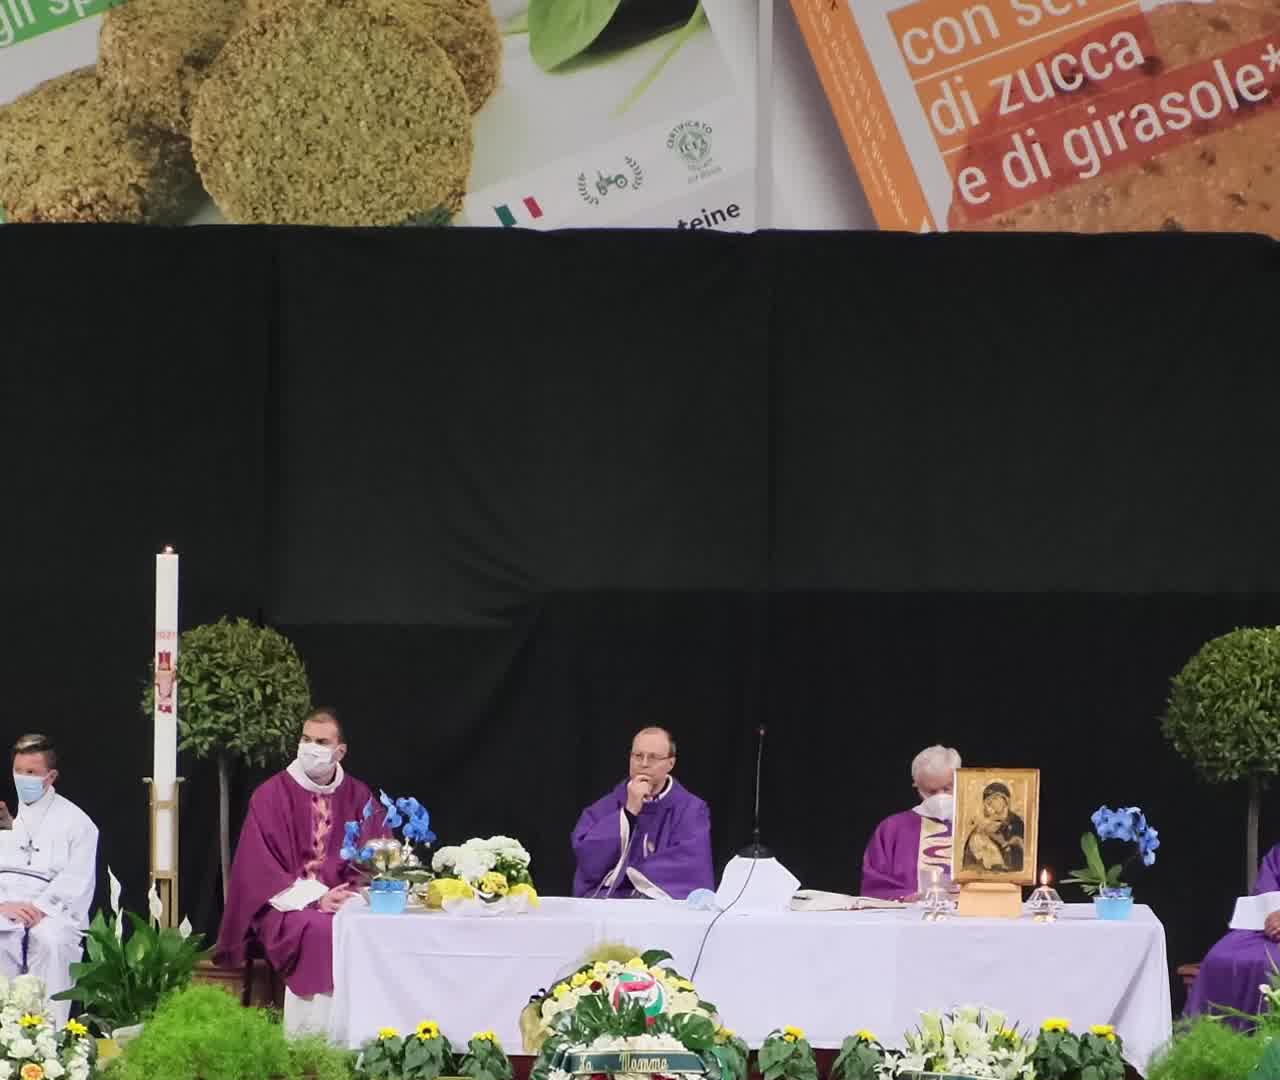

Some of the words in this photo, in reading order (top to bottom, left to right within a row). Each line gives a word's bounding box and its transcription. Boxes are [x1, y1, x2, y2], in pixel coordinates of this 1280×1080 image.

[902, 4, 1000, 65] con
[930, 76, 981, 136] di
[989, 31, 1145, 116] zucca
[957, 165, 991, 204] e
[1002, 127, 1052, 188] di
[677, 204, 741, 231] teine
